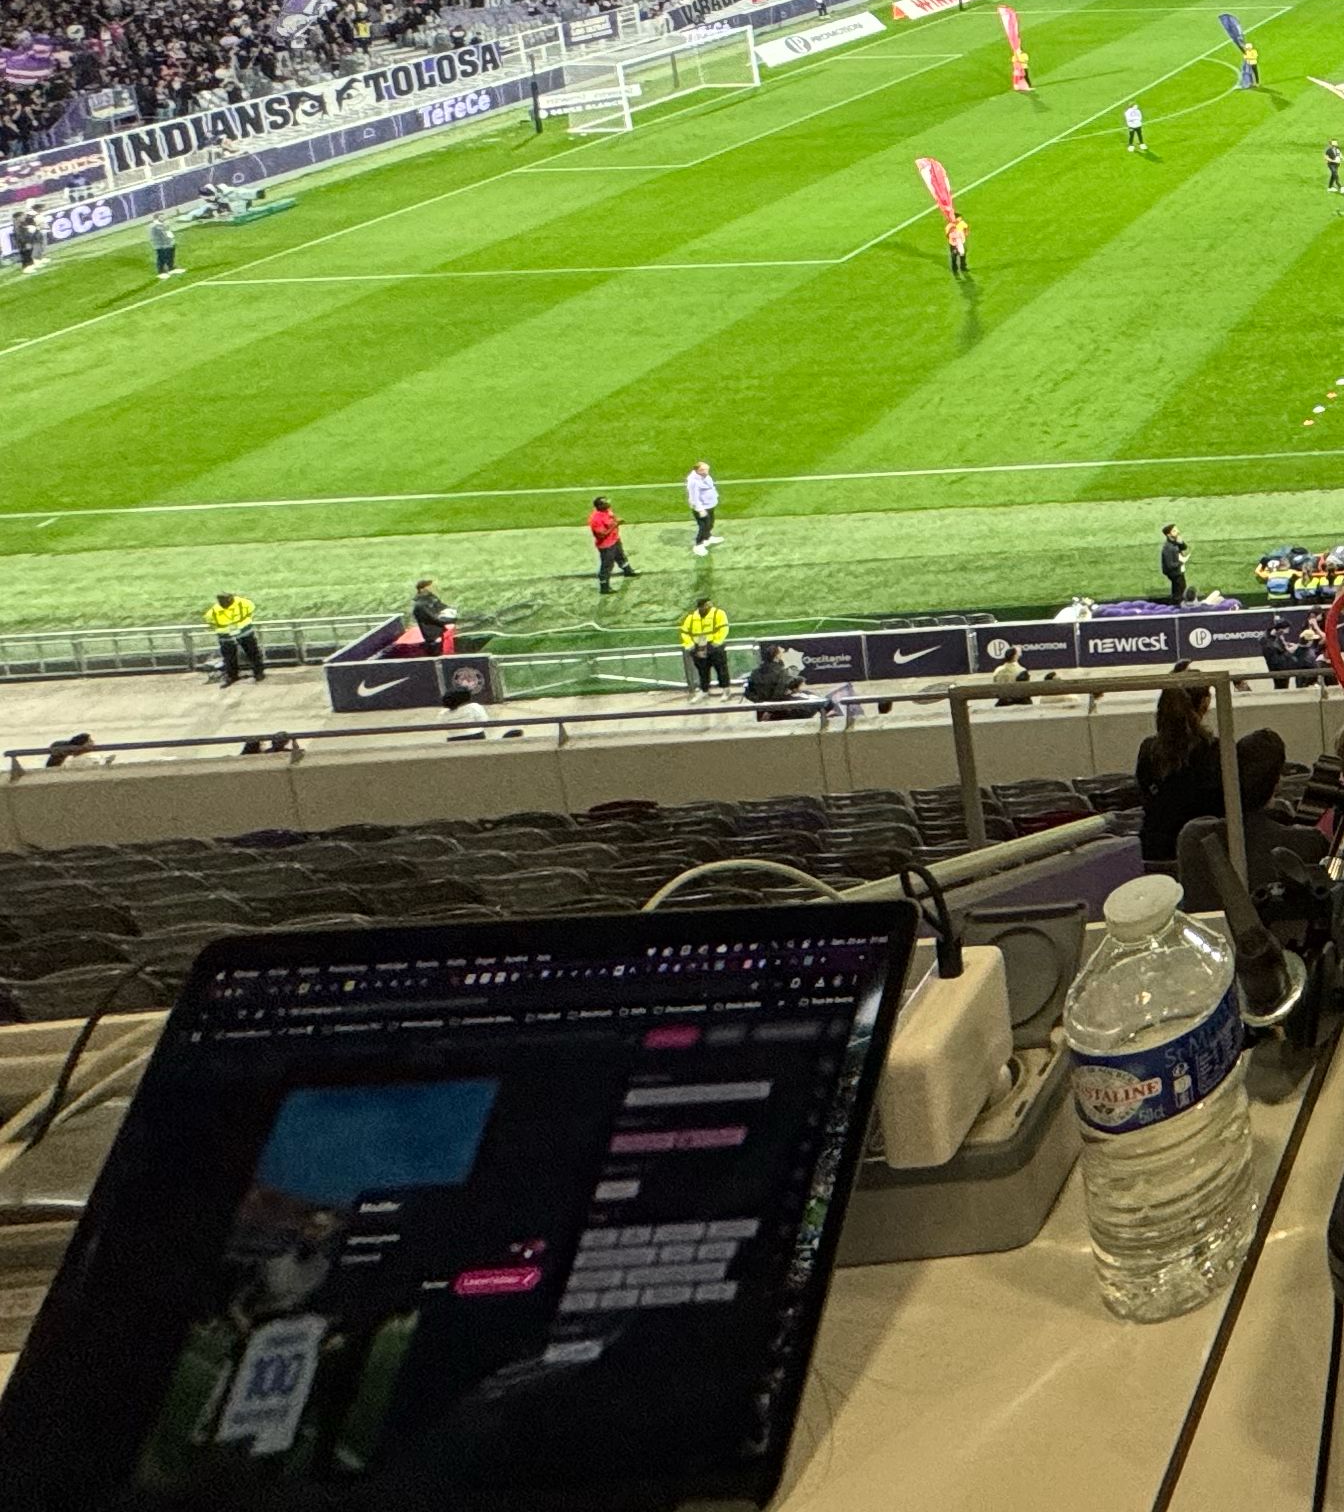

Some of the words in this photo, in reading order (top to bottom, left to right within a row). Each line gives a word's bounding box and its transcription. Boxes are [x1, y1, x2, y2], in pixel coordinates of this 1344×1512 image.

[810, 21, 865, 45] PROMOTION
[109, 90, 299, 173] INDIANS
[363, 43, 501, 103] TOLOSA
[418, 91, 491, 129] TéFéCé
[802, 653, 852, 665] Occitanie
